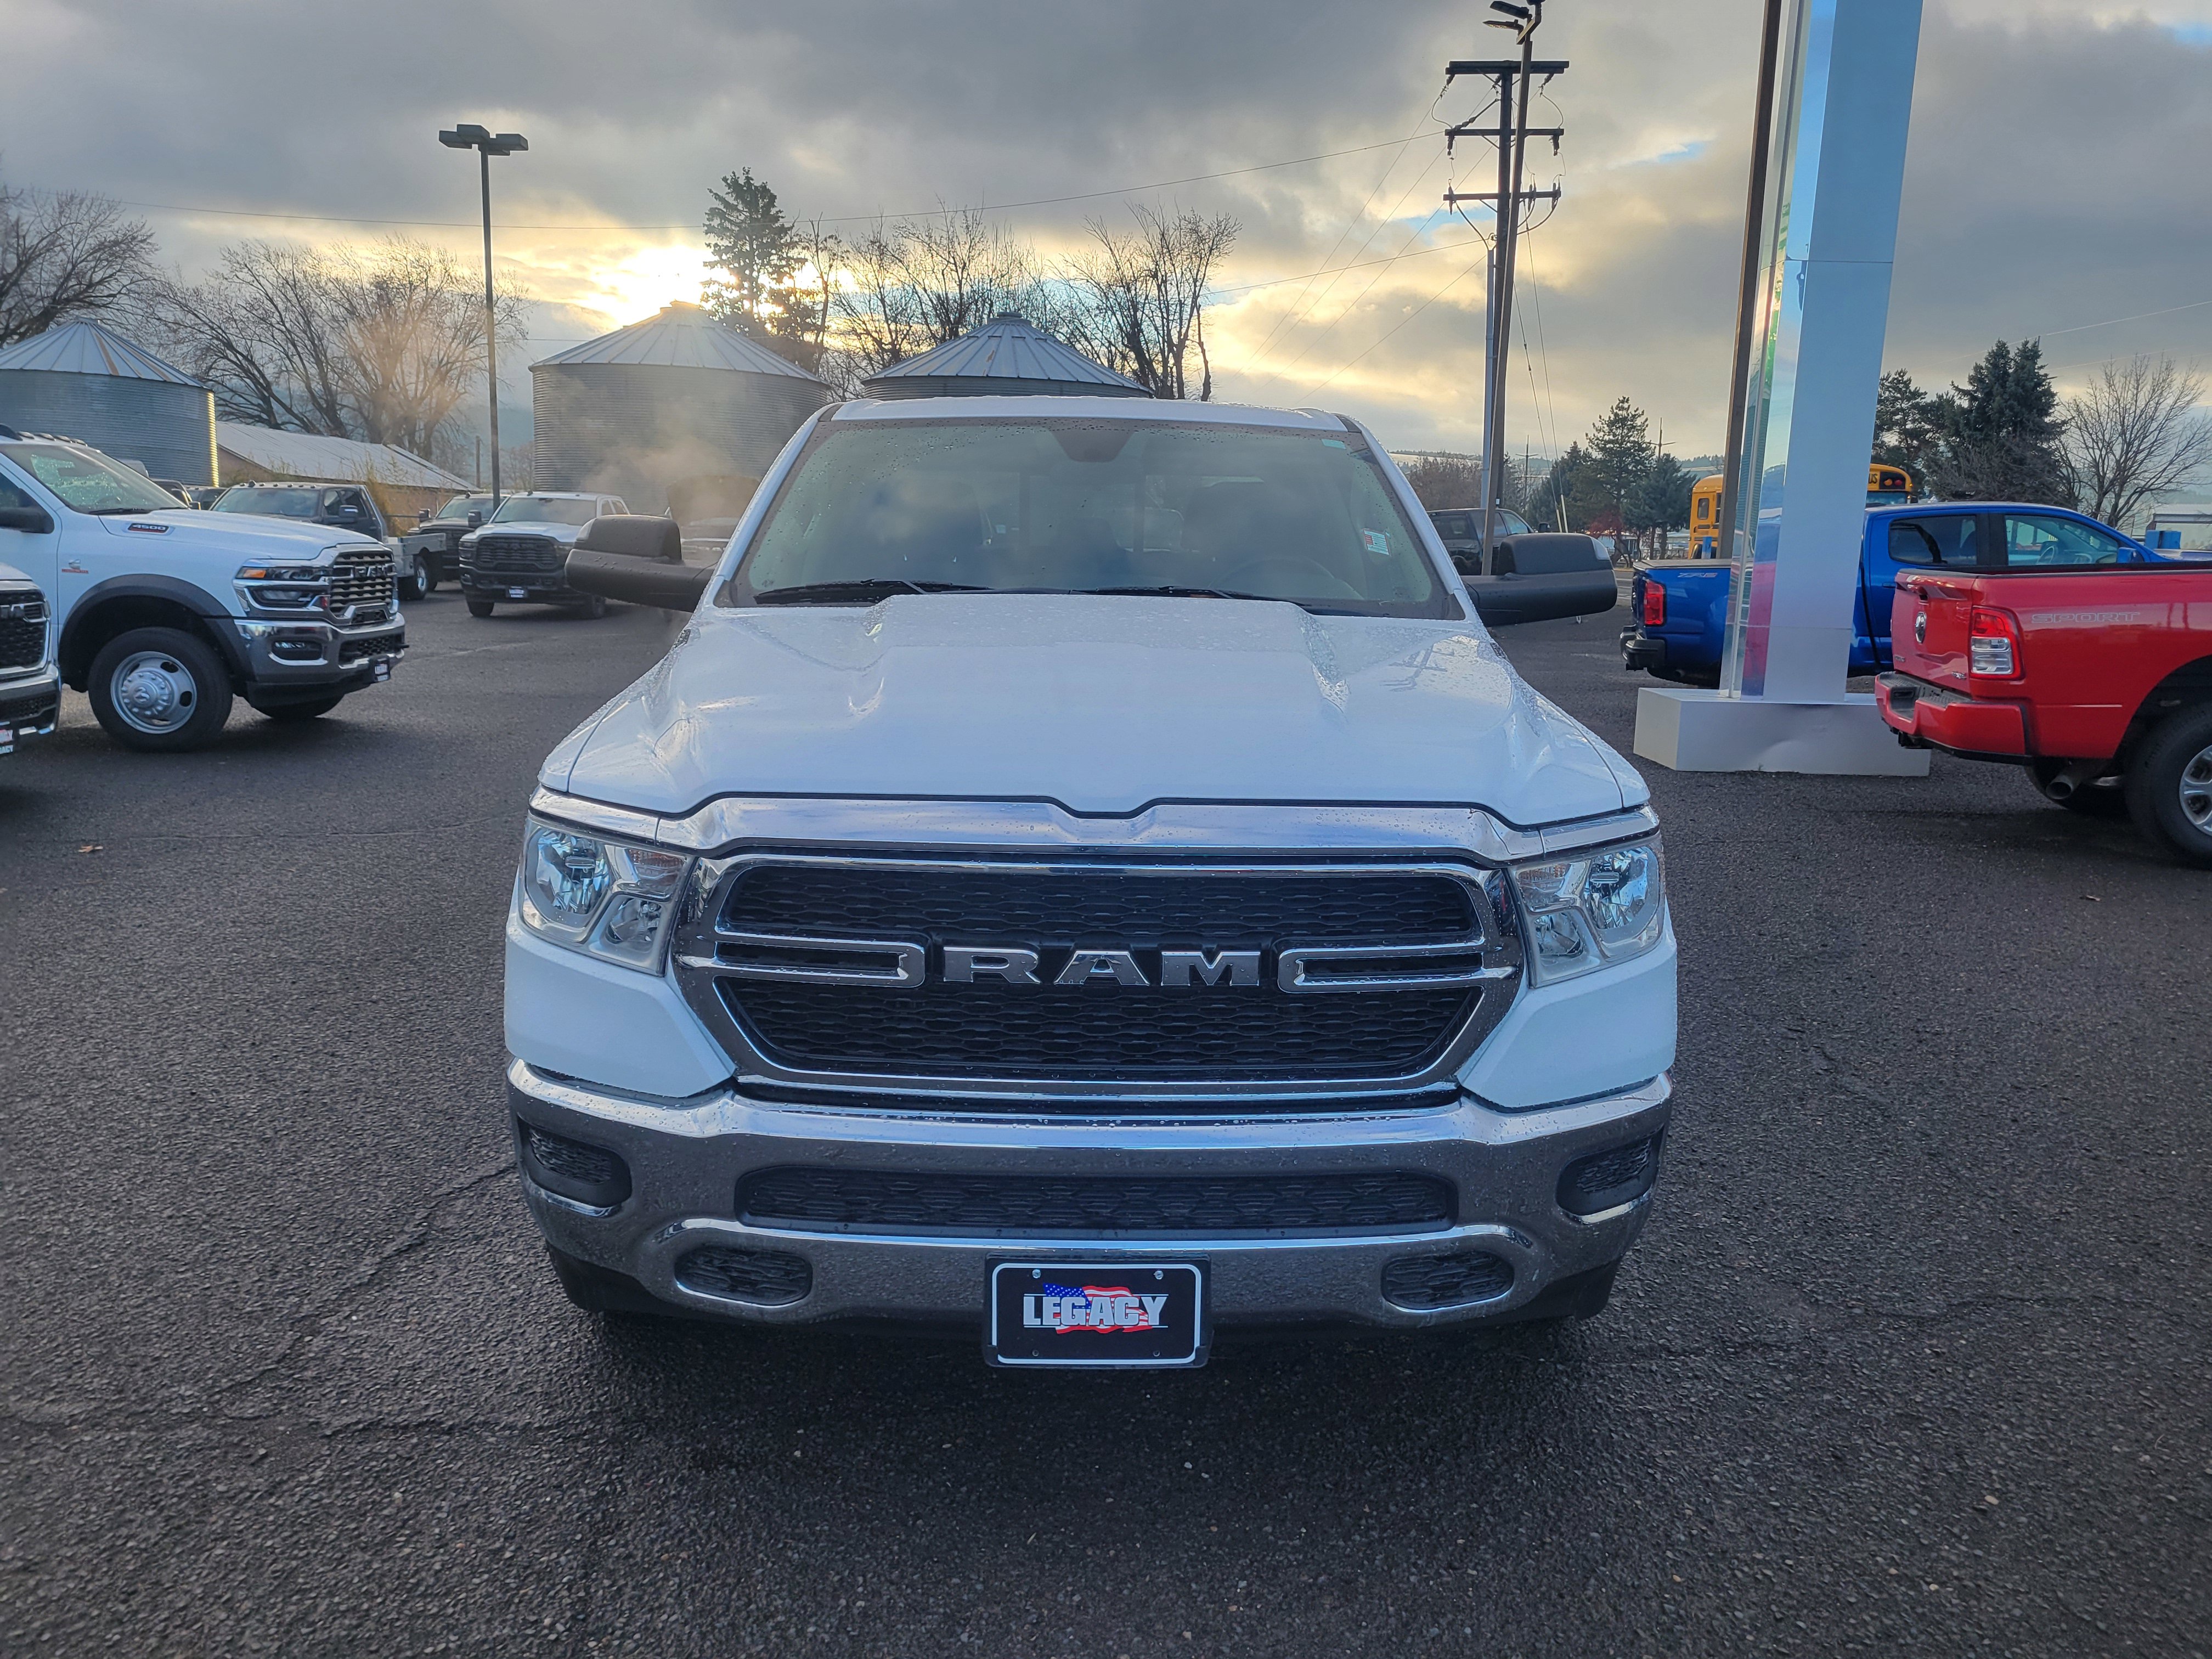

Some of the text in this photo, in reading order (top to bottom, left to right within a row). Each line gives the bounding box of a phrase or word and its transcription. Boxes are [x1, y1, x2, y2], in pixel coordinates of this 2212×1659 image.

[1869, 473, 1877, 484] US
[2032, 612, 2140, 623] SPORT
[943, 946, 1261, 986] RAM
[1023, 1296, 1169, 1326] LEGACY
